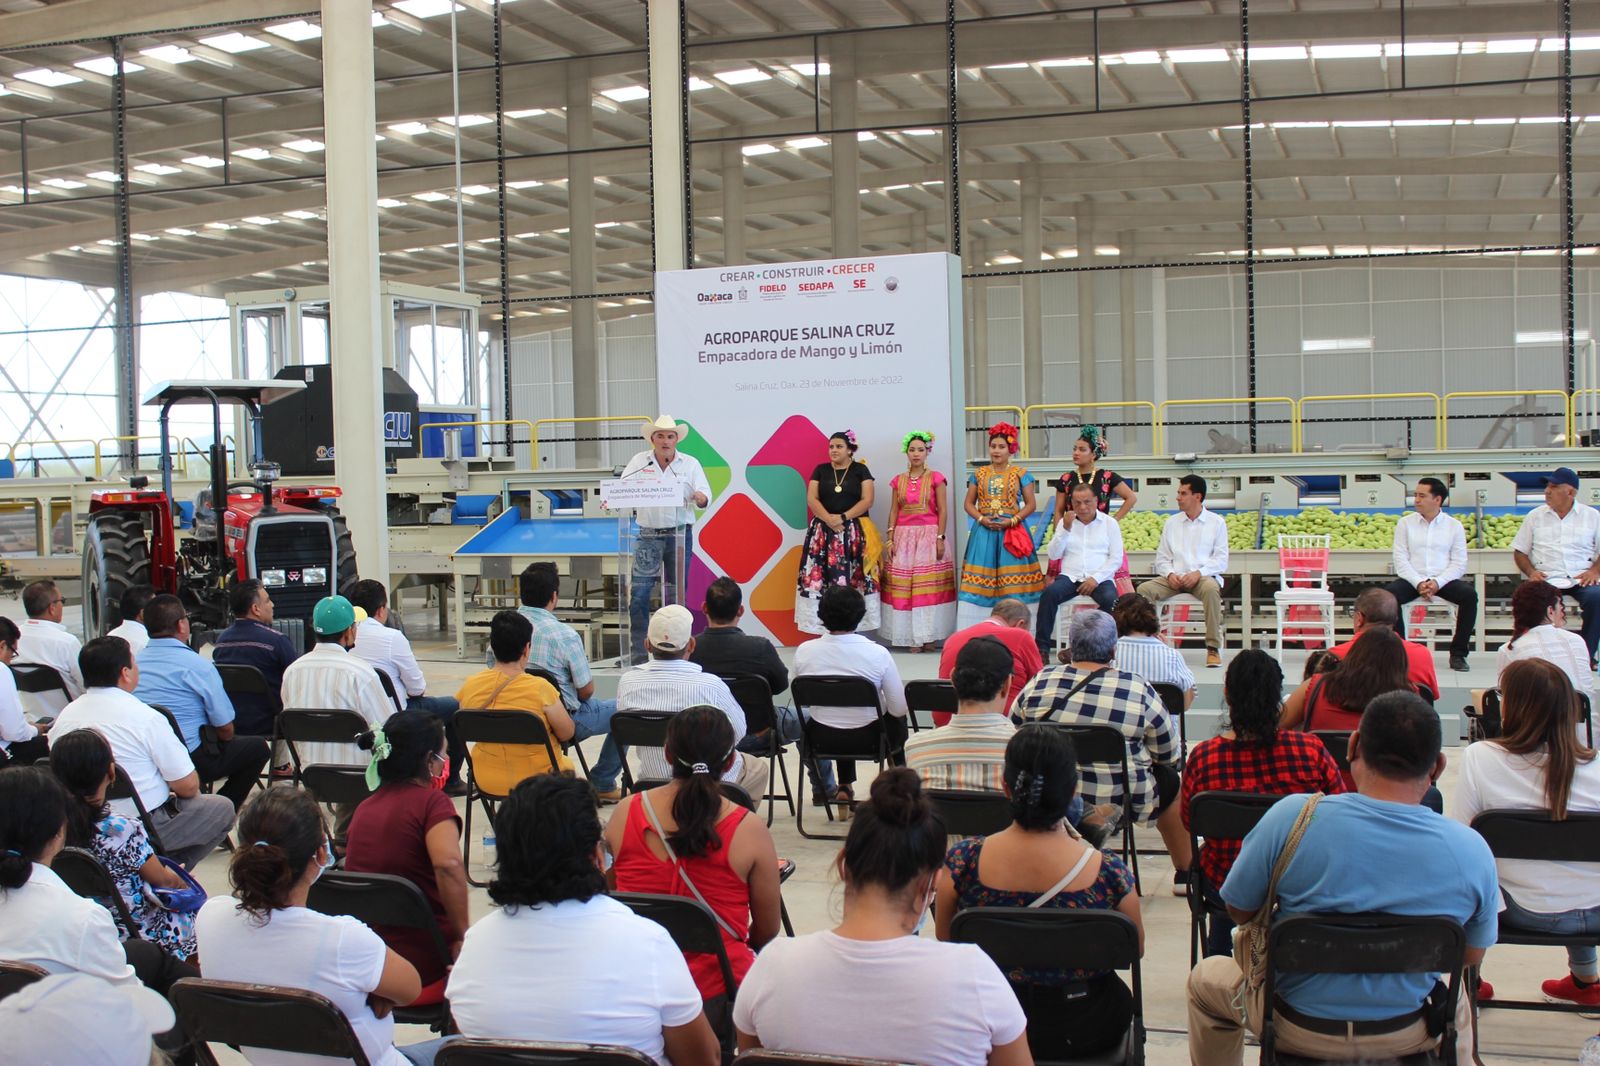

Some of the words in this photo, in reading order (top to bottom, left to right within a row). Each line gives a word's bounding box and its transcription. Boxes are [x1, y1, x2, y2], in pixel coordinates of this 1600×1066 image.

[720, 272, 755, 282] CREAR
[763, 266, 824, 280] CONSTRUIR
[832, 263, 875, 275] CRECER
[760, 284, 786, 292] FIDELO
[798, 282, 834, 291] SEDAPA
[853, 279, 866, 288] SE
[697, 292, 733, 302] Oaxaca
[704, 329, 798, 345] AGROPARQUE
[802, 325, 852, 340] SALINA
[856, 323, 895, 337] CRUZ
[698, 348, 777, 364] Empacadora
[781, 345, 796, 359] de
[800, 345, 845, 360] Mango
[849, 346, 857, 358] y
[861, 341, 902, 355] Limón
[735, 382, 758, 391] Salina
[800, 380, 810, 388] 23
[811, 378, 821, 388] de
[824, 376, 867, 387] Noviembre
[869, 377, 879, 385] de
[880, 376, 904, 384] 2022
